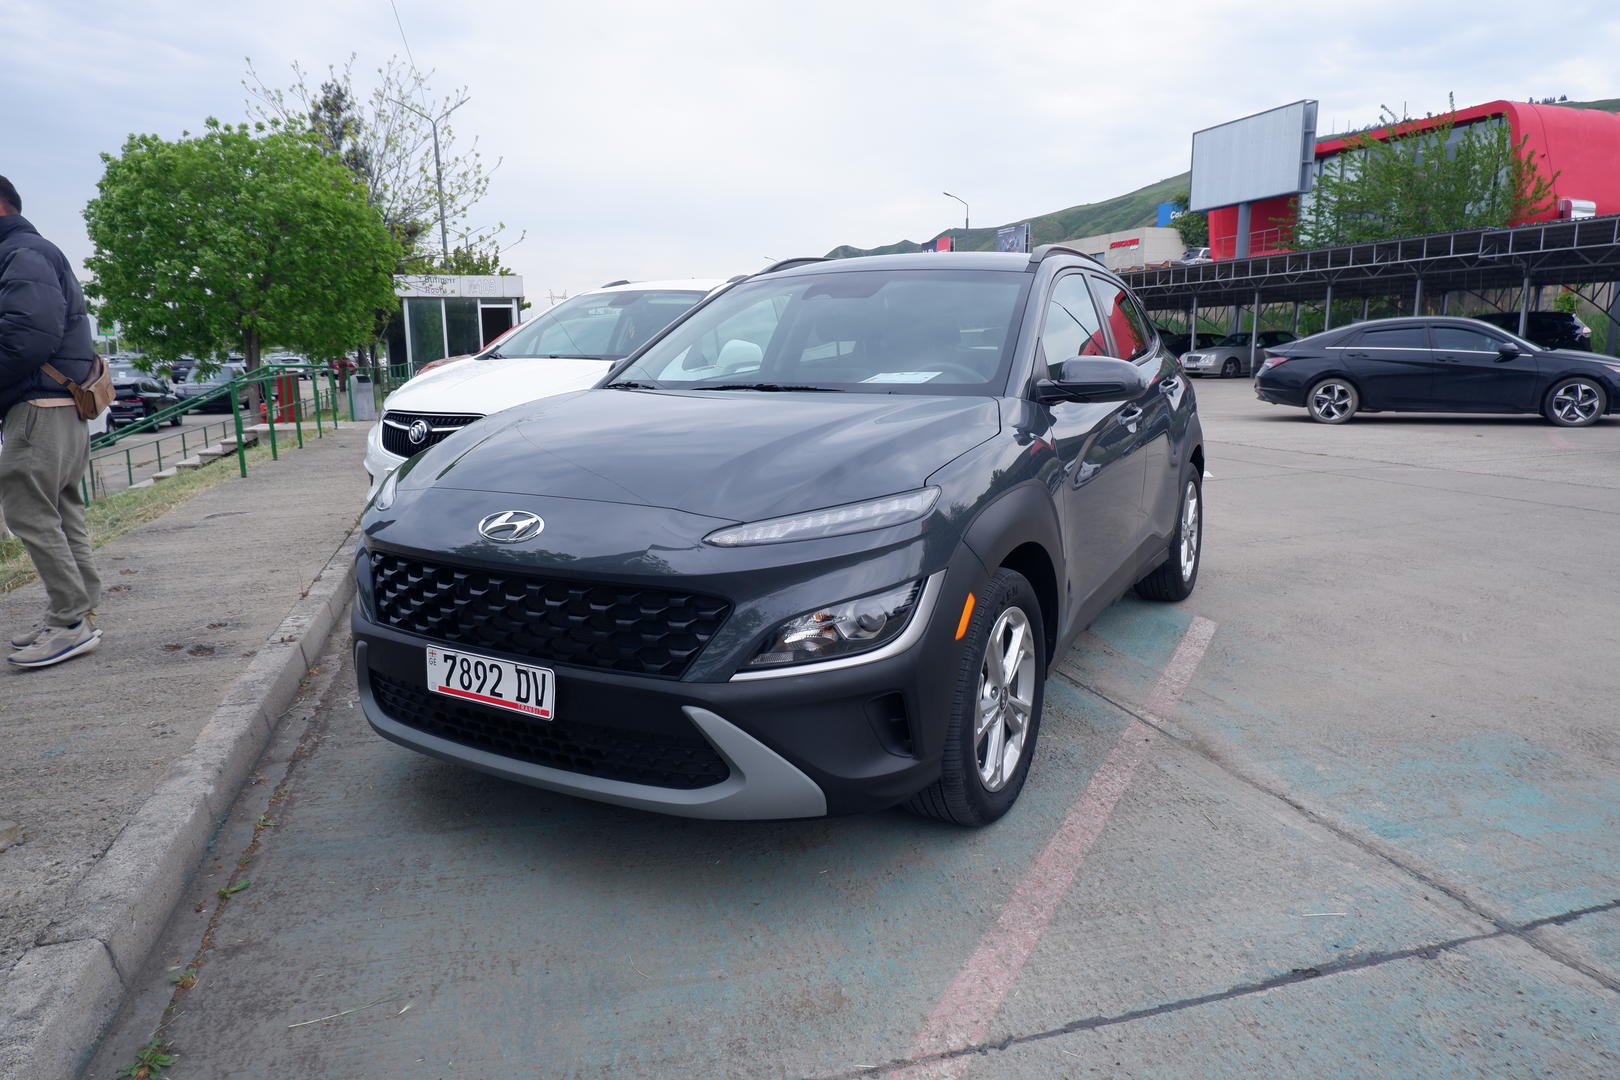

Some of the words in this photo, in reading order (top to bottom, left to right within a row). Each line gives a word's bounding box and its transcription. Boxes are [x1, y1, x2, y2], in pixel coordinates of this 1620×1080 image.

[428, 657, 437, 666] GE
[443, 653, 503, 698] 7892
[515, 665, 546, 707] DV
[517, 703, 542, 715] TRANSIT
